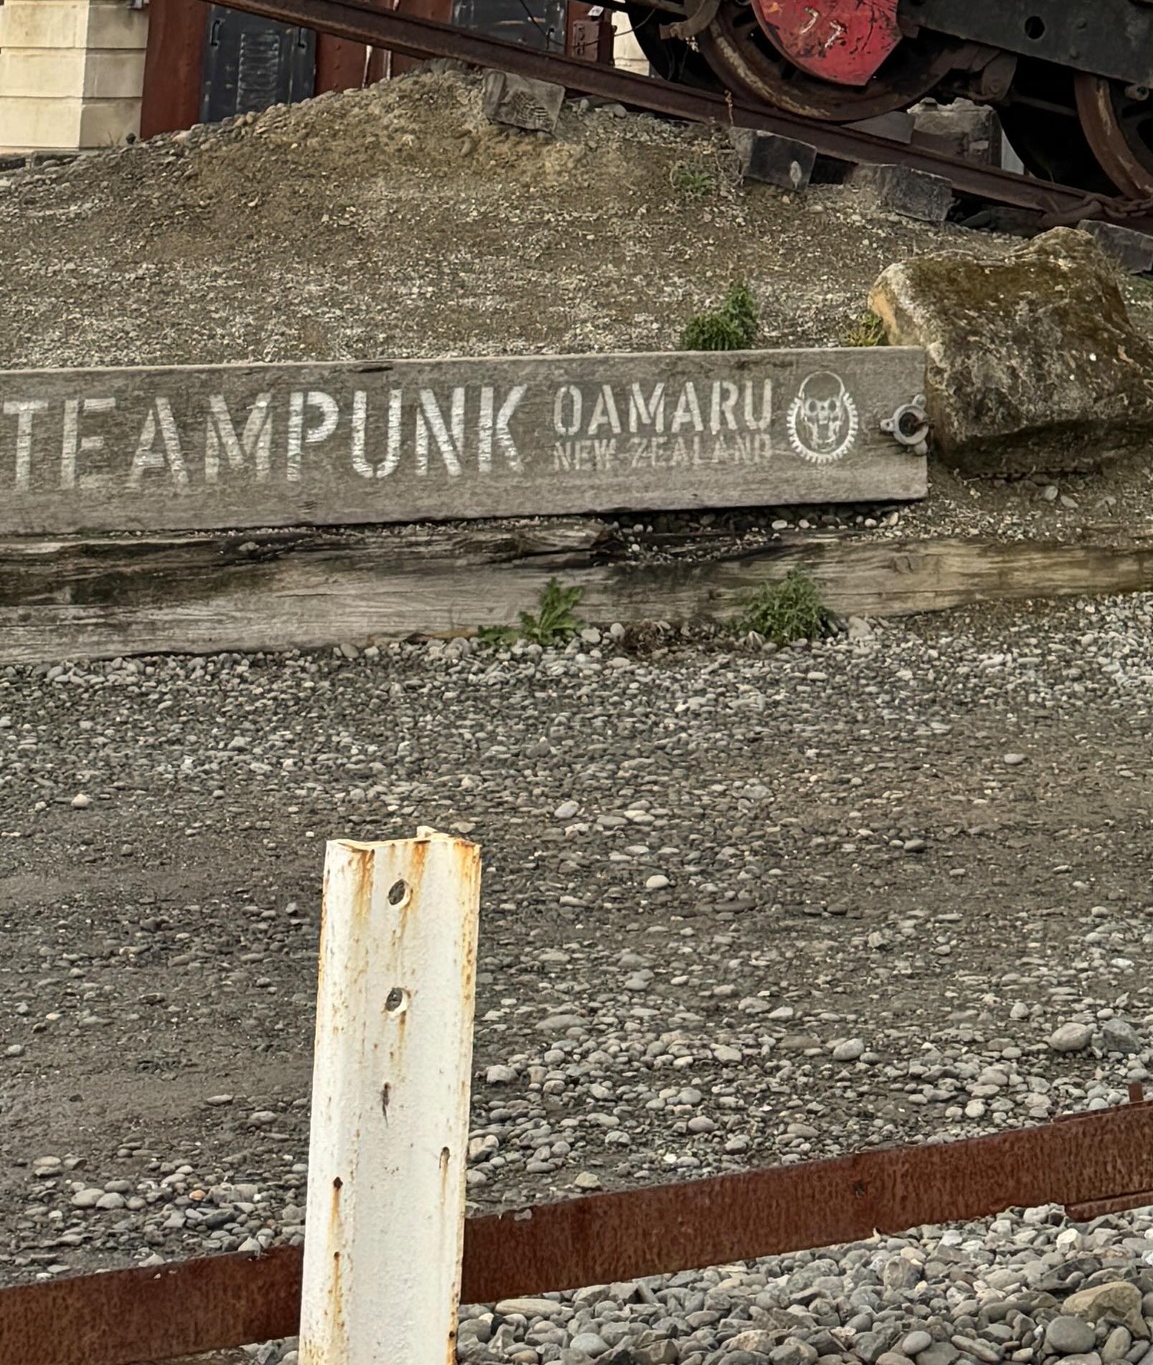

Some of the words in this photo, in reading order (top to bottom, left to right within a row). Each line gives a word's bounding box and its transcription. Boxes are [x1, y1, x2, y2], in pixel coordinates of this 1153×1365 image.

[553, 378, 773, 436] OAMARU
[553, 435, 618, 470] NEW
[626, 433, 773, 468] ZEALAND
